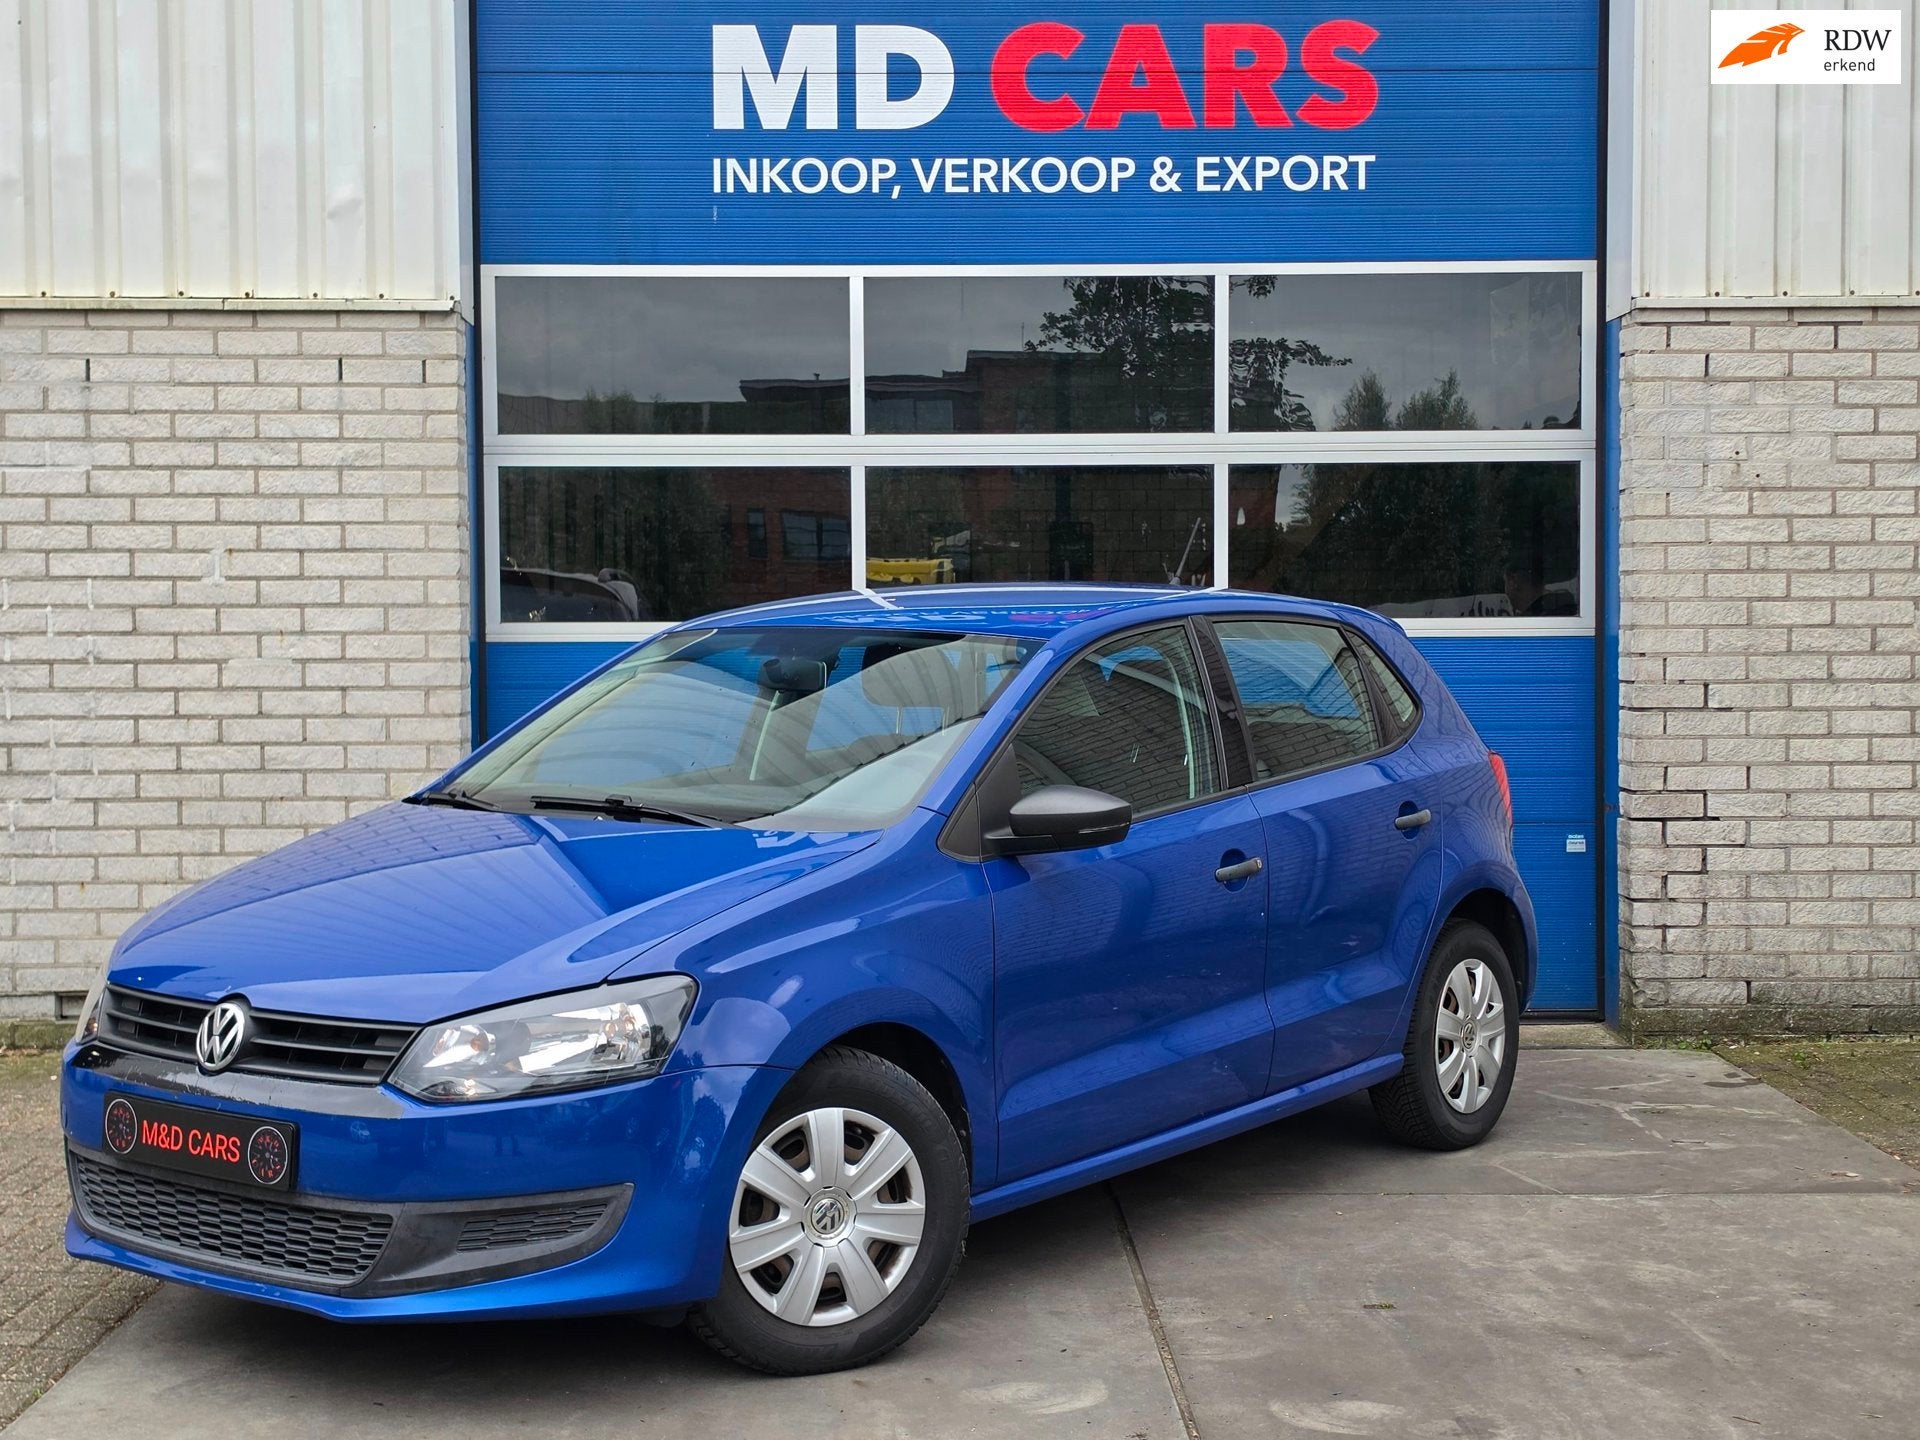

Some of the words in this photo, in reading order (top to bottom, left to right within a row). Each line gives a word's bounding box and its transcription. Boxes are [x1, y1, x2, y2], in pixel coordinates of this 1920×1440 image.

[712, 24, 955, 130] MD
[990, 20, 1380, 133] CARS
[713, 157, 901, 199] INKOOP,
[910, 156, 1136, 194] VERKOOP
[1149, 156, 1183, 193] &
[1196, 154, 1376, 192] EXPORT
[141, 1119, 184, 1151] M&D
[187, 1128, 241, 1164] CARS
